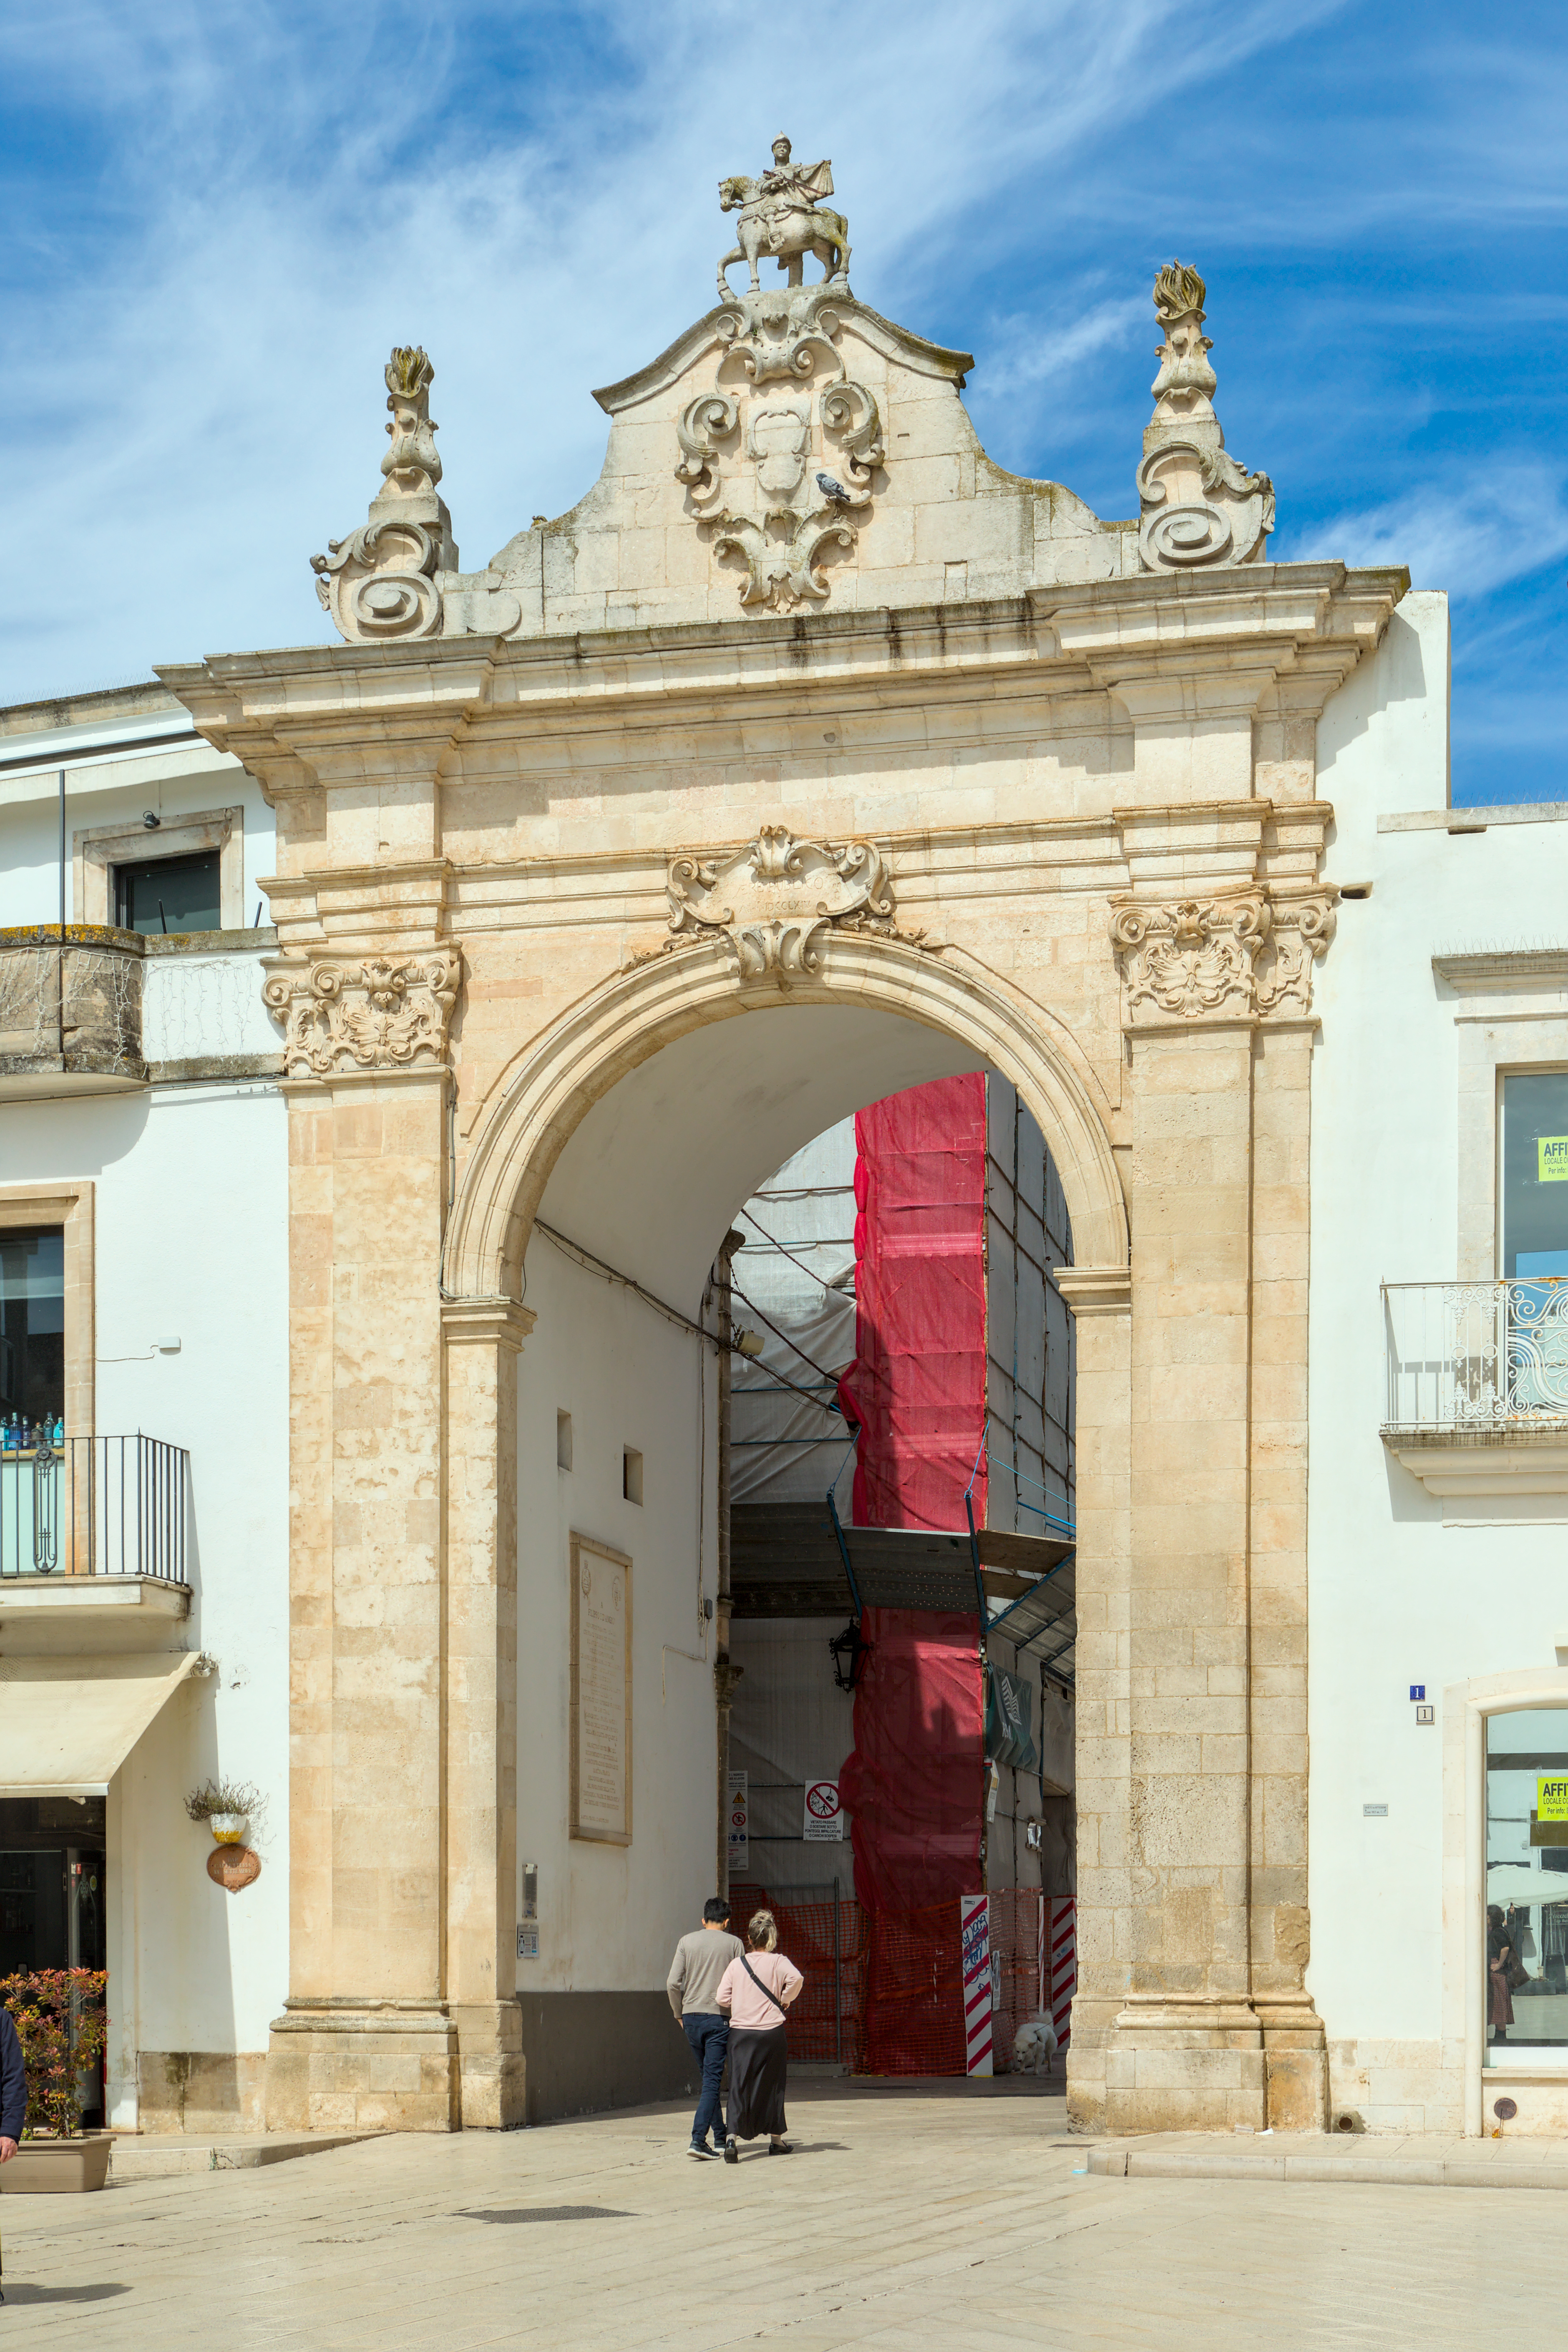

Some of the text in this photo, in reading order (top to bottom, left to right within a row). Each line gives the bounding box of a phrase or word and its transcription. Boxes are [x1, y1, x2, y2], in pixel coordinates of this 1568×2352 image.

[1544, 1142, 1568, 1157] AFFI
[588, 1608, 599, 1619] FILIPPO
[1415, 1687, 1420, 1698] 1
[1423, 1709, 1427, 1719] 1
